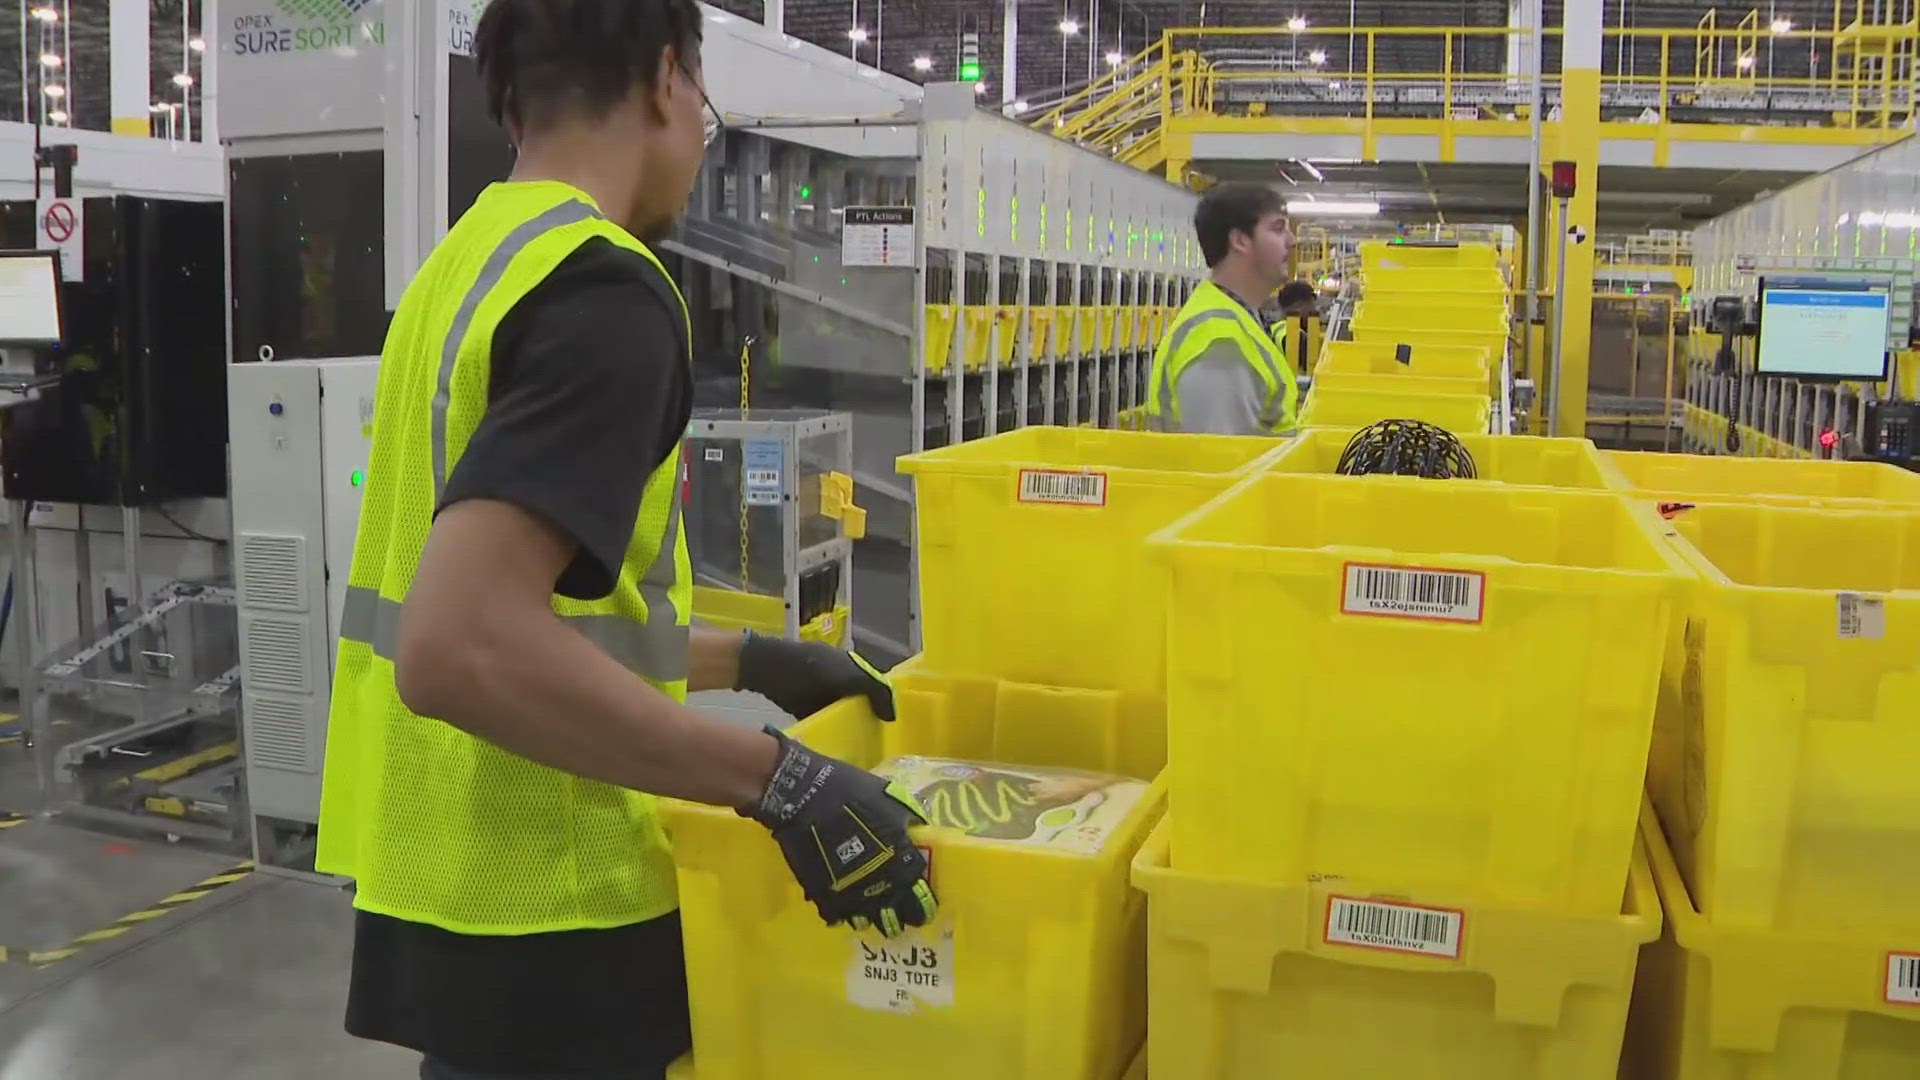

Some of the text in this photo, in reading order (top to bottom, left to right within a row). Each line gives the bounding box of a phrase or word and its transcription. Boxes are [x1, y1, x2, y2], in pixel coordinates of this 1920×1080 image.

[234, 15, 272, 31] OPEX
[449, 9, 468, 27] PEX
[855, 211, 903, 222] PTL Actions
[864, 965, 940, 987] SNJ3 TOTE
